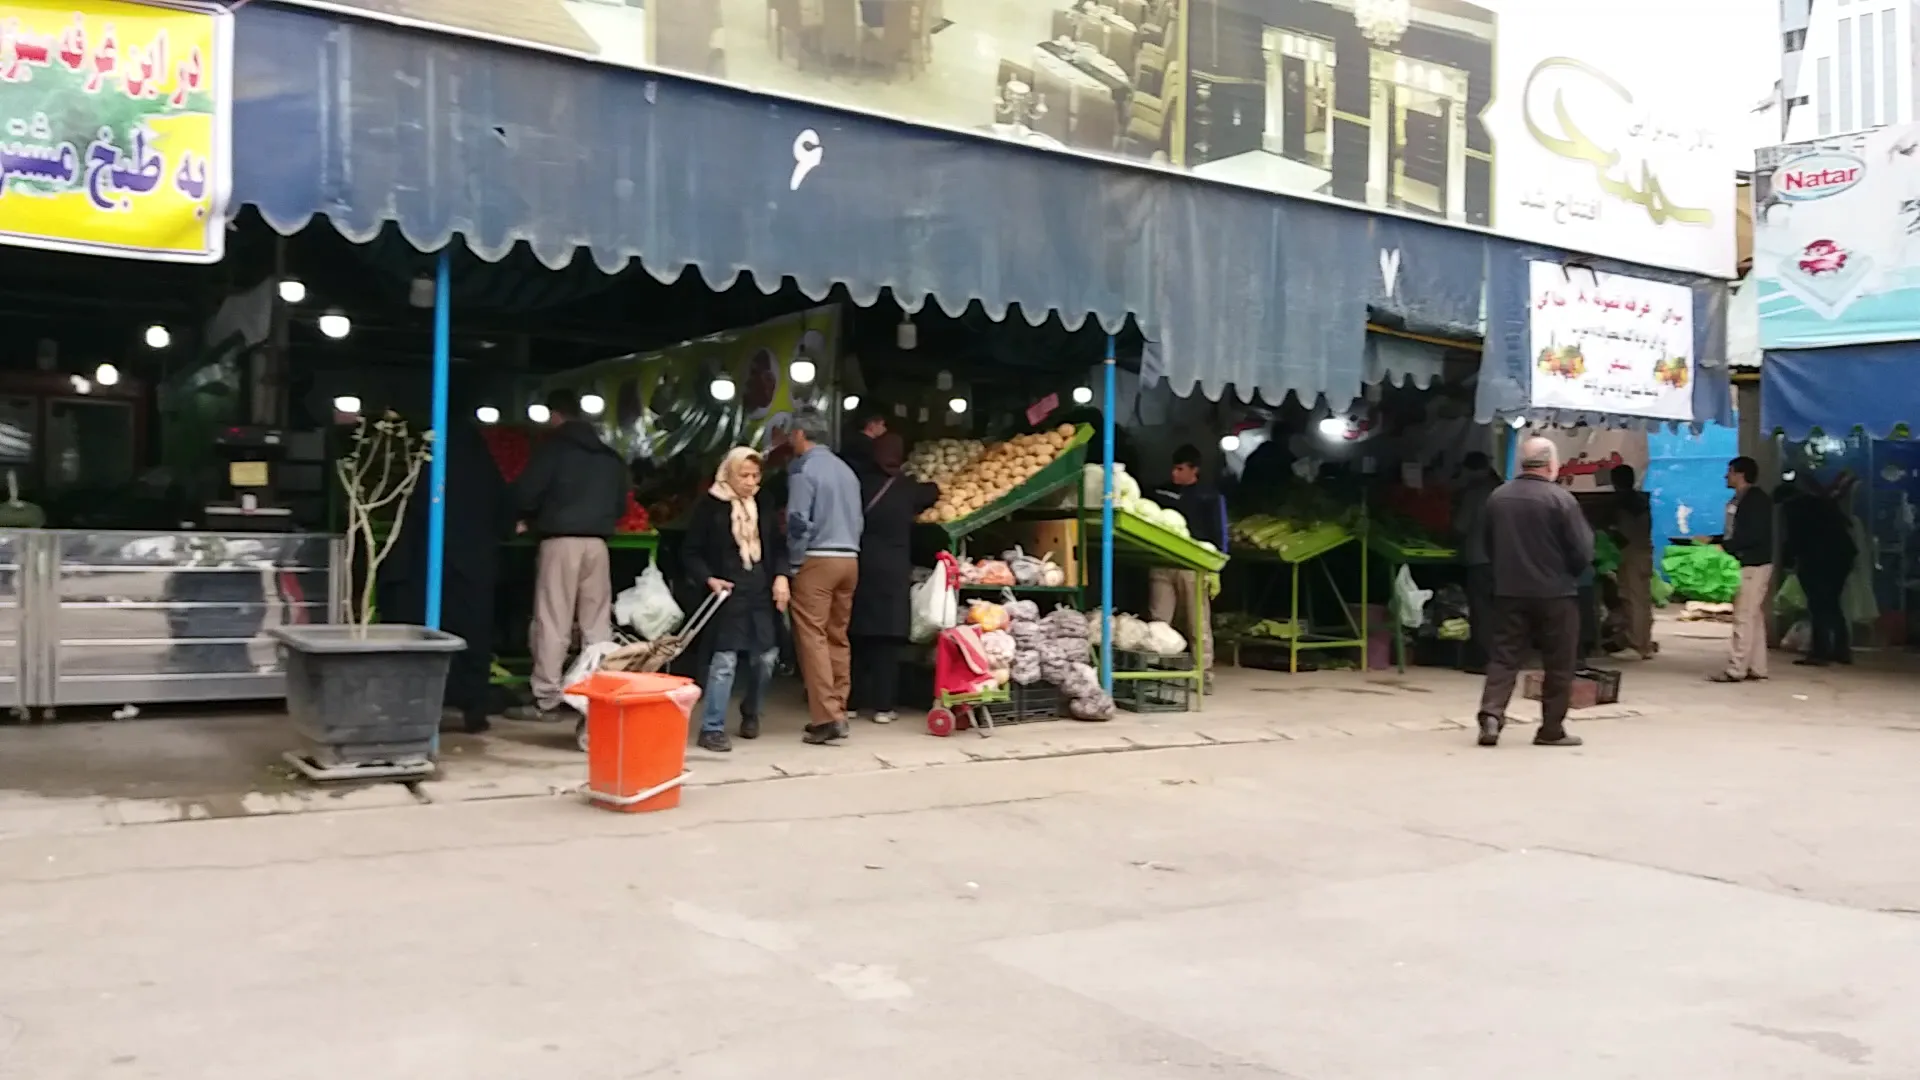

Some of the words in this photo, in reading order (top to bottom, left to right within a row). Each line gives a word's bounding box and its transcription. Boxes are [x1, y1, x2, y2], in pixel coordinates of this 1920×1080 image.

[88, 128, 160, 210] طبخ
[177, 153, 207, 216] به
[789, 128, 824, 191] ۶
[1785, 166, 1860, 191] Natar
[1519, 186, 1548, 210] شد
[1553, 192, 1603, 225] افتتاح
[1379, 247, 1400, 298] ۷
